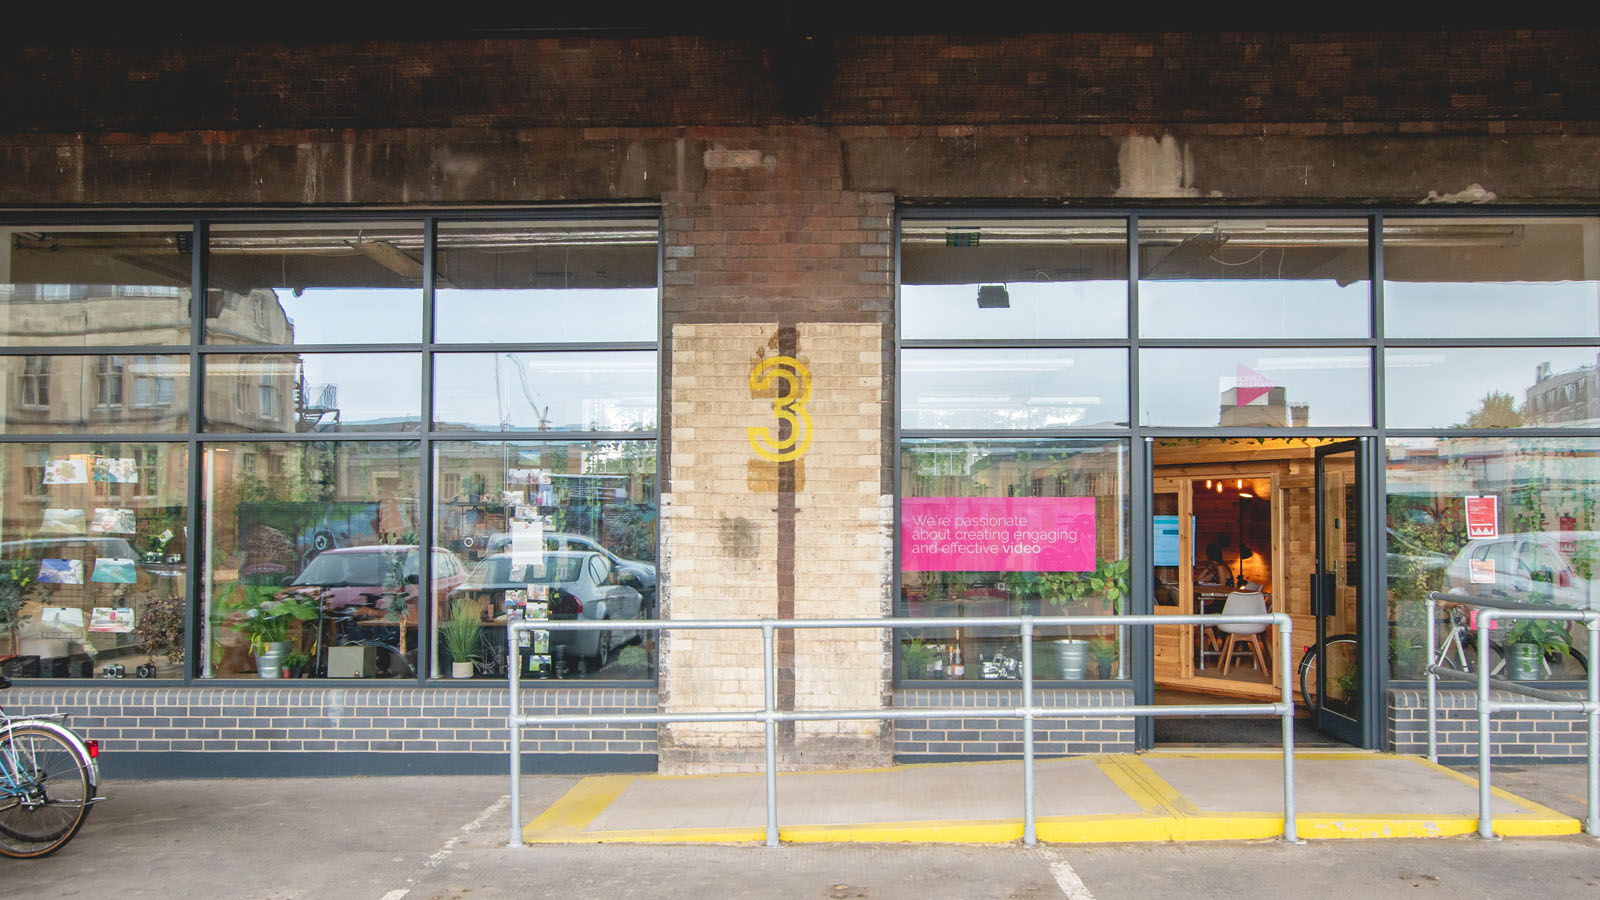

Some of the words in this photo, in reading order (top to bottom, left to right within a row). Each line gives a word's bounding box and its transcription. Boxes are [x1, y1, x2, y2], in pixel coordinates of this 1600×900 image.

[747, 355, 814, 462] 3
[912, 514, 951, 527] We're
[954, 514, 1028, 529] passionate
[912, 528, 952, 541] about
[954, 528, 1010, 543] creating
[1013, 528, 1078, 544] engaging
[912, 541, 938, 554] and
[941, 541, 1000, 554] effective
[1002, 542, 1041, 554] video
